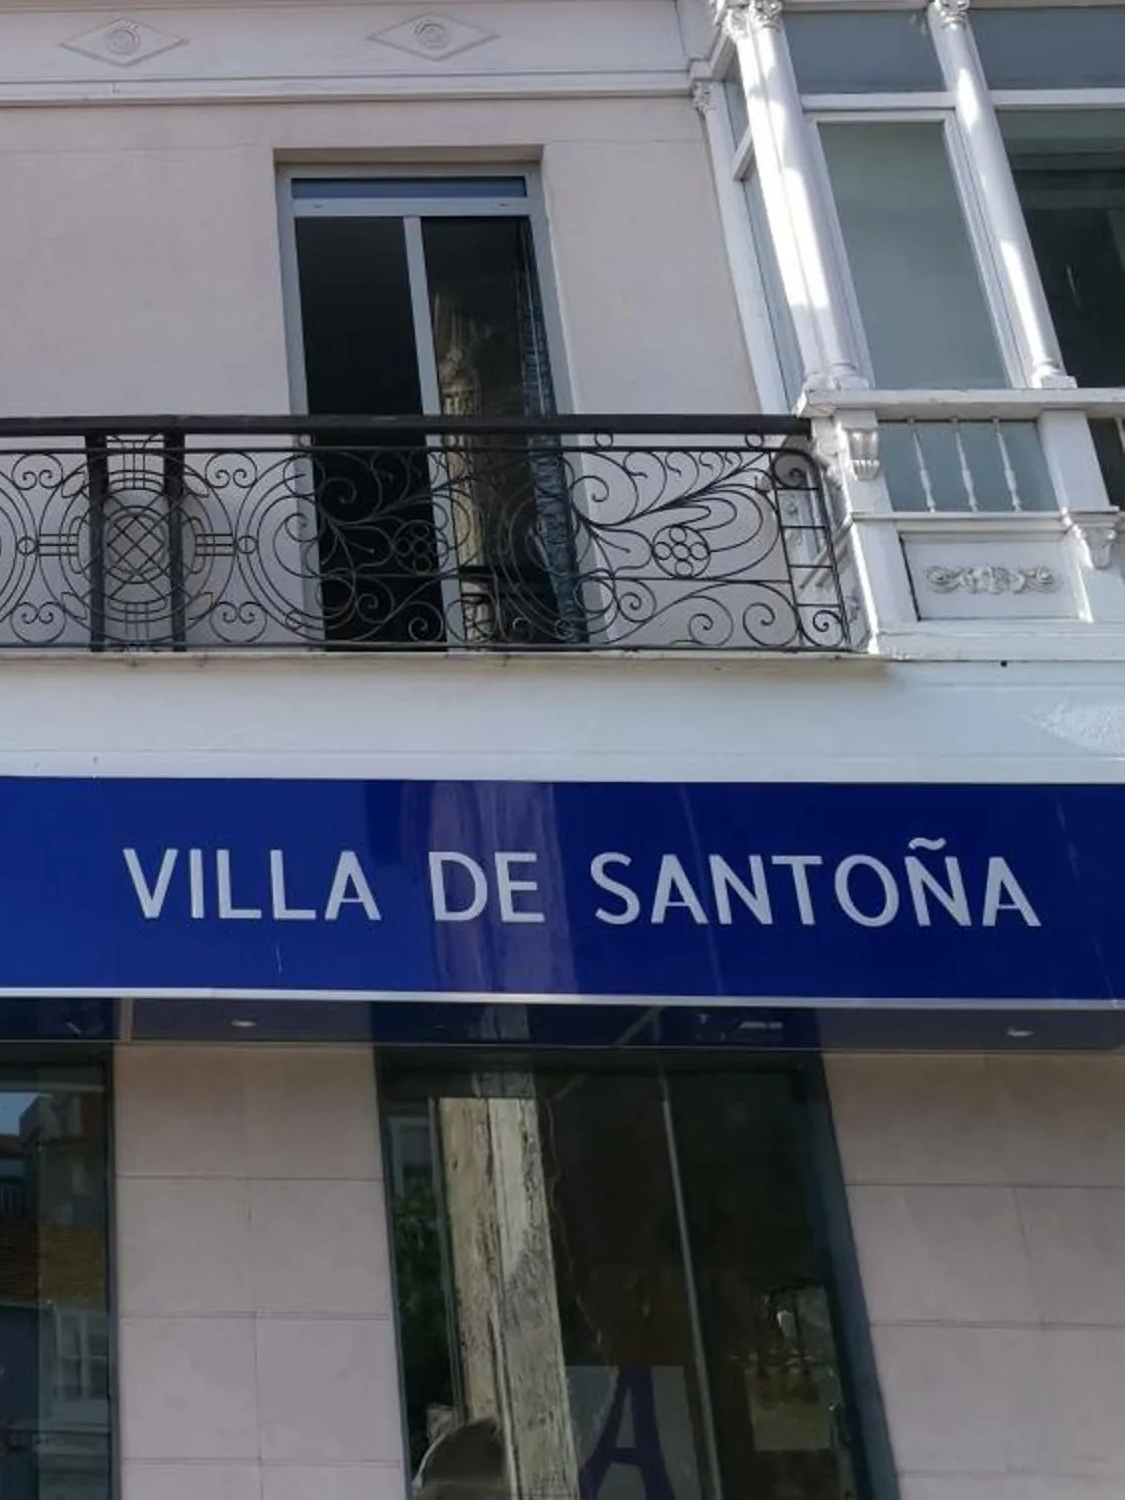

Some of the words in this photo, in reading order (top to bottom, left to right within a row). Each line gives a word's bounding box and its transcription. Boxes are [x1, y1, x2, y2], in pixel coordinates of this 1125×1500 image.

[123, 849, 380, 919] VILLA
[428, 851, 544, 922] DE
[590, 837, 1040, 926] SANTOÑA
